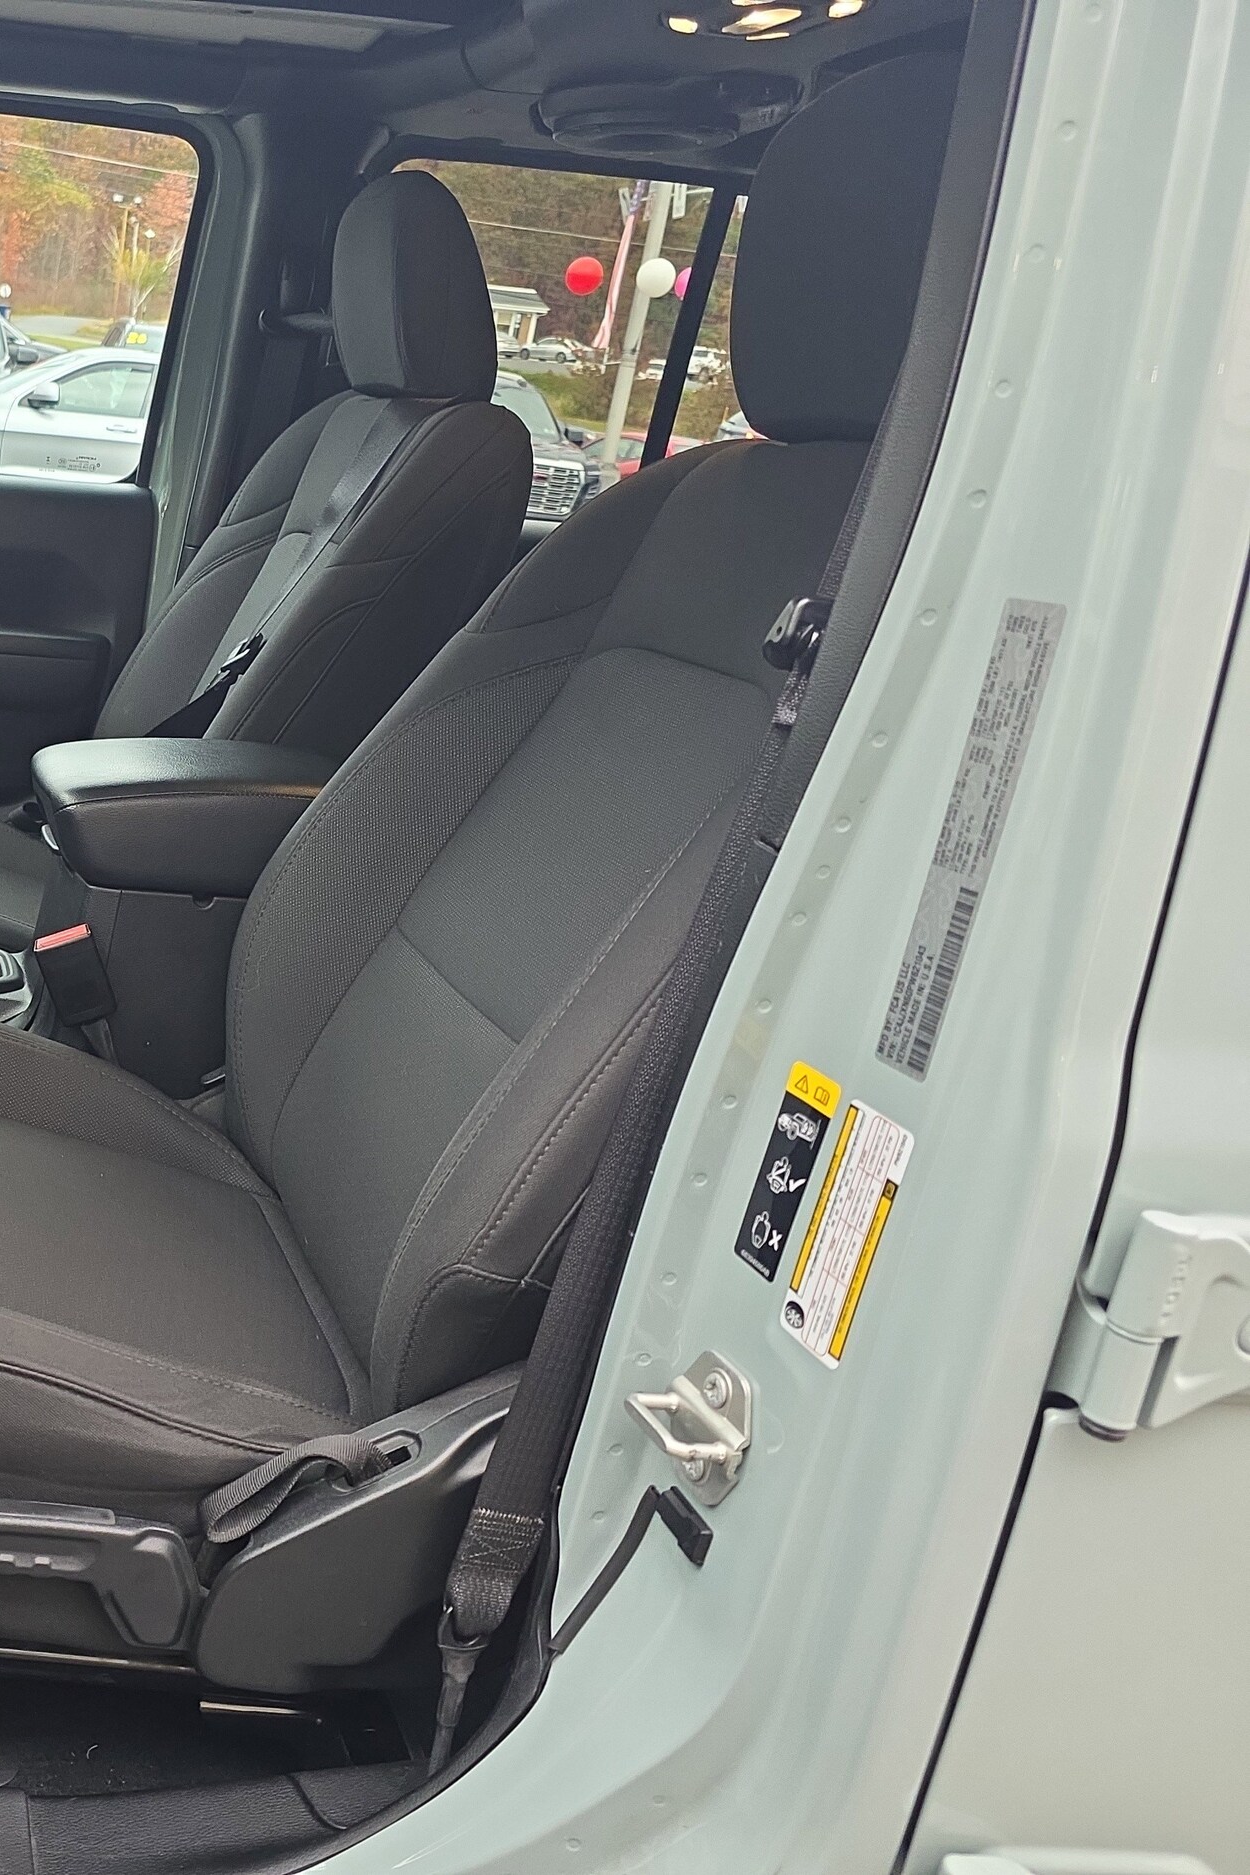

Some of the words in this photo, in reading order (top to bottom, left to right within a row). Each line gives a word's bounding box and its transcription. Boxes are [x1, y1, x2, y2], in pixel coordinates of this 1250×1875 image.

[899, 960, 910, 980] LLC
[894, 979, 905, 995] US
[888, 994, 900, 1014] FCA
[894, 1025, 912, 1066] VEHICLE
[906, 996, 921, 1026] MADE
